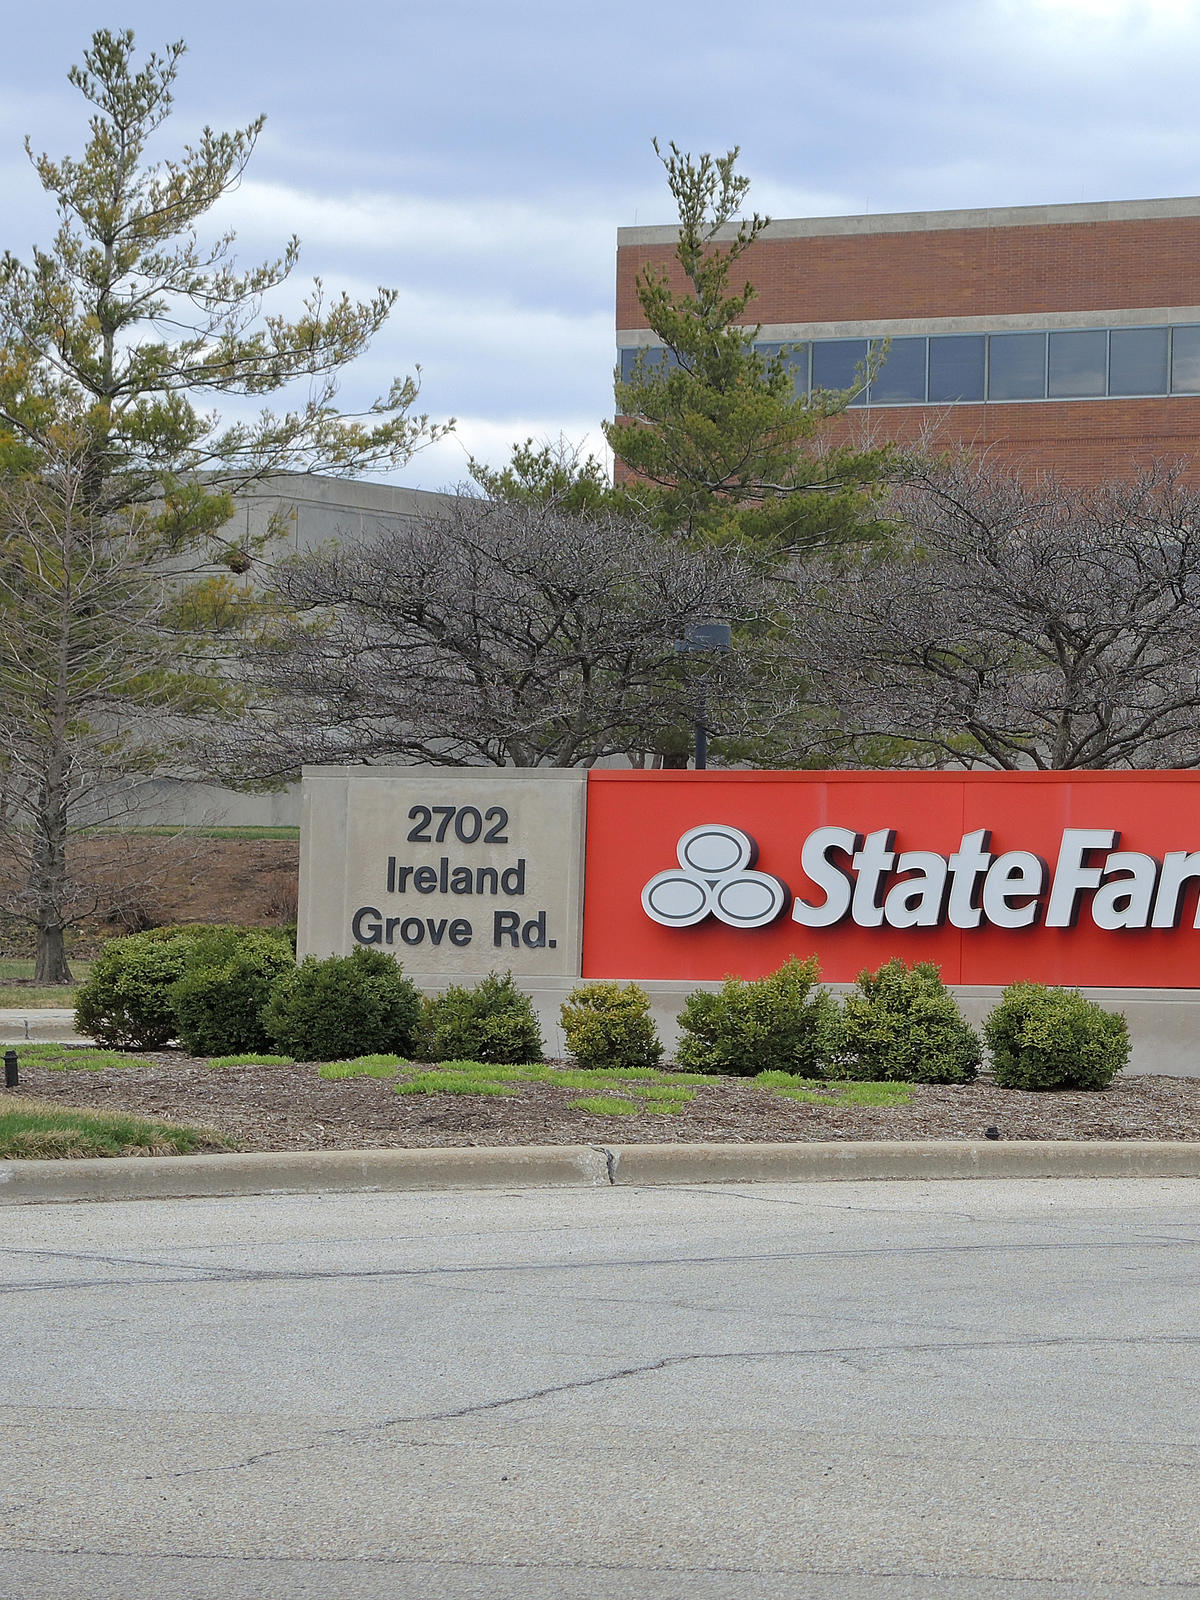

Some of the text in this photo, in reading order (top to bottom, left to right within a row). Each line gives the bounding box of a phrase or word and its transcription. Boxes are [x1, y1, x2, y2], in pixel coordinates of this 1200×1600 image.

[407, 805, 509, 843] 2702
[386, 856, 526, 895] Ireland
[352, 906, 557, 948] Grove Rd.
